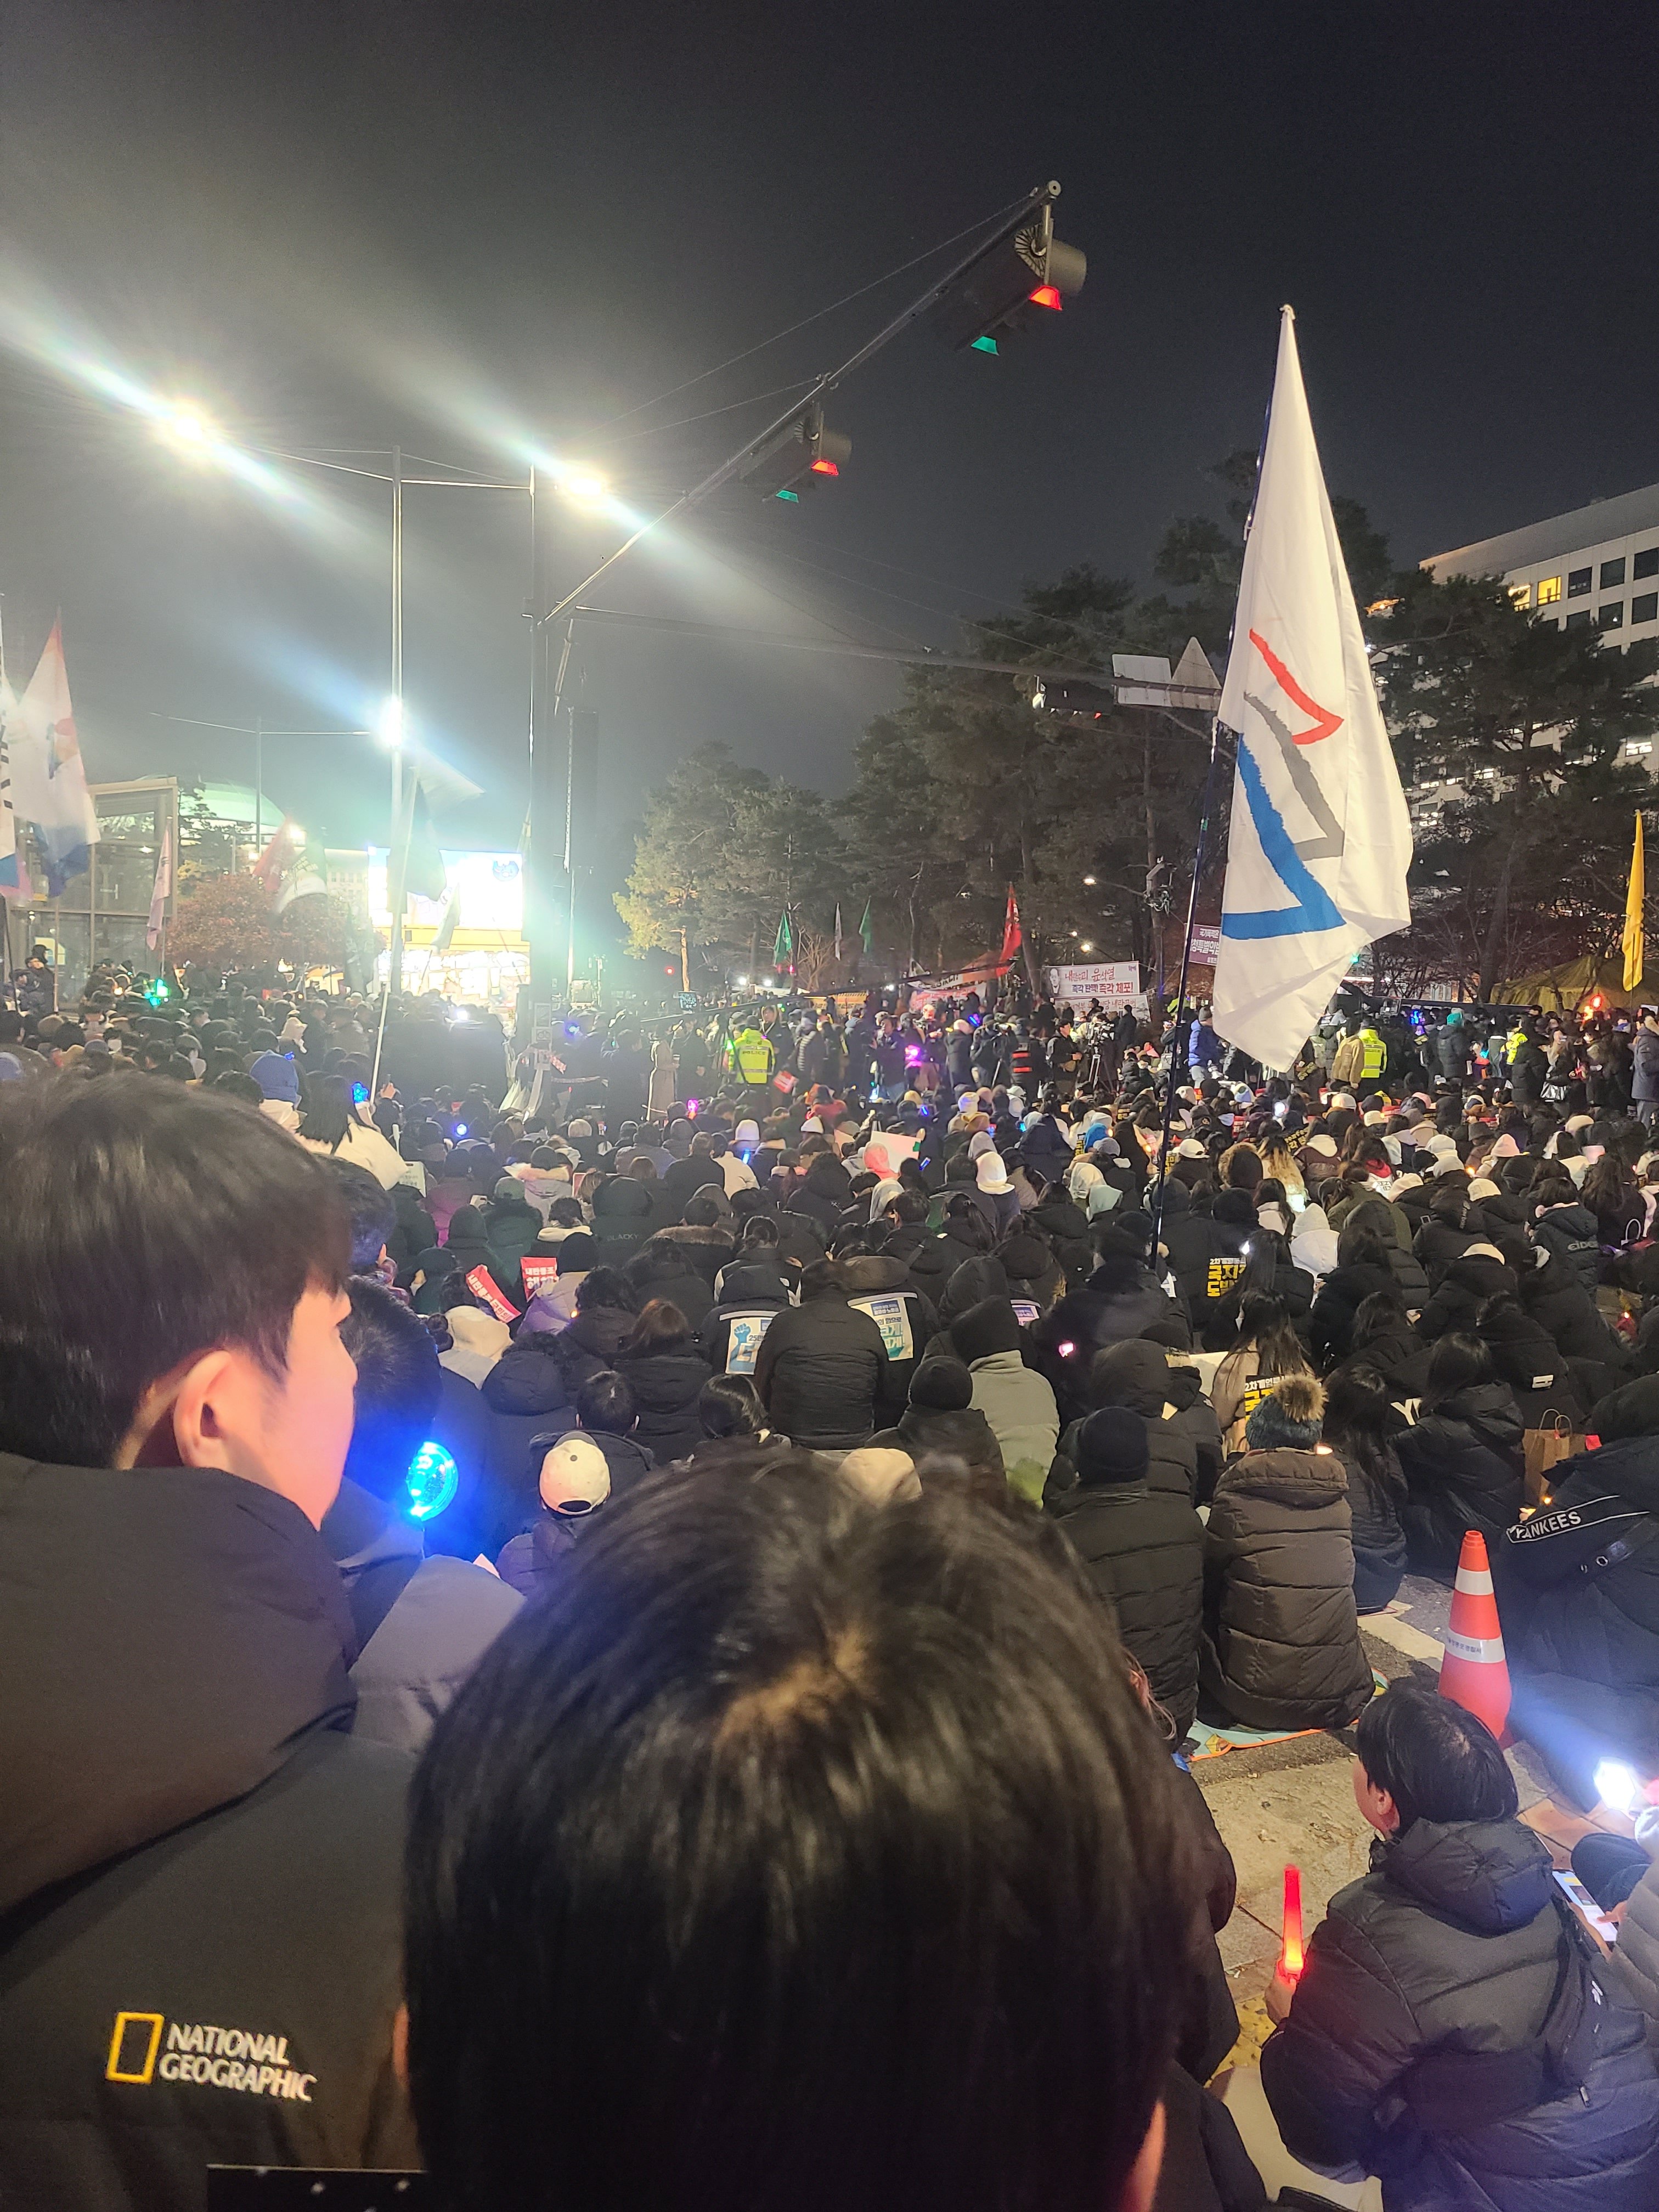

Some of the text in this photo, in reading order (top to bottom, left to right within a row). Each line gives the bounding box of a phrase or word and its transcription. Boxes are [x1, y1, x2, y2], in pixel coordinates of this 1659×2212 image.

[1072, 984, 1083, 993] 즉각
[1099, 983, 1114, 994] 즉각
[1116, 982, 1133, 994] 체포!
[1091, 967, 1115, 981] 윤석열
[525, 1267, 554, 1276] 내란동조
[467, 1274, 493, 1302] 내란동조
[1516, 1511, 1581, 1539] YANKEES
[167, 2023, 290, 2066] NATIONAL
[159, 2053, 318, 2102] GEOGRAPHIC
